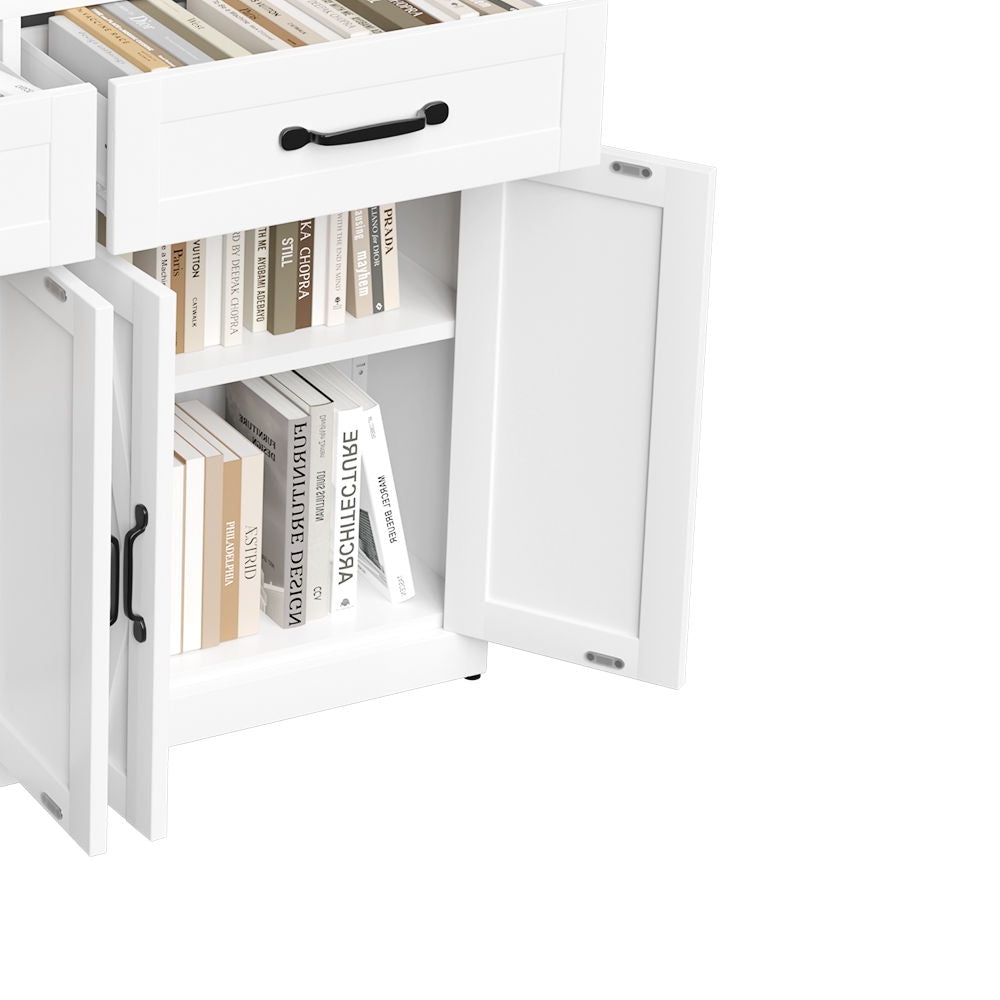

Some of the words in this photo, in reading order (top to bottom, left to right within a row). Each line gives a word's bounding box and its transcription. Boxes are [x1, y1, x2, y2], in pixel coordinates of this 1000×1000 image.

[384, 208, 394, 255] PRADA
[173, 248, 184, 277] Paris
[192, 239, 200, 278] VUITTON
[281, 237, 294, 268] STILL
[231, 260, 240, 295] DEEPAK
[257, 257, 266, 289] AYOBAMI
[298, 246, 311, 300] CHOPRA
[357, 250, 371, 297] mayhem
[230, 298, 240, 335] CHOPRA
[256, 291, 266, 323] ADEBAYO
[225, 521, 236, 587] PHILADELPHIA
[244, 525, 258, 580] ASTRID
